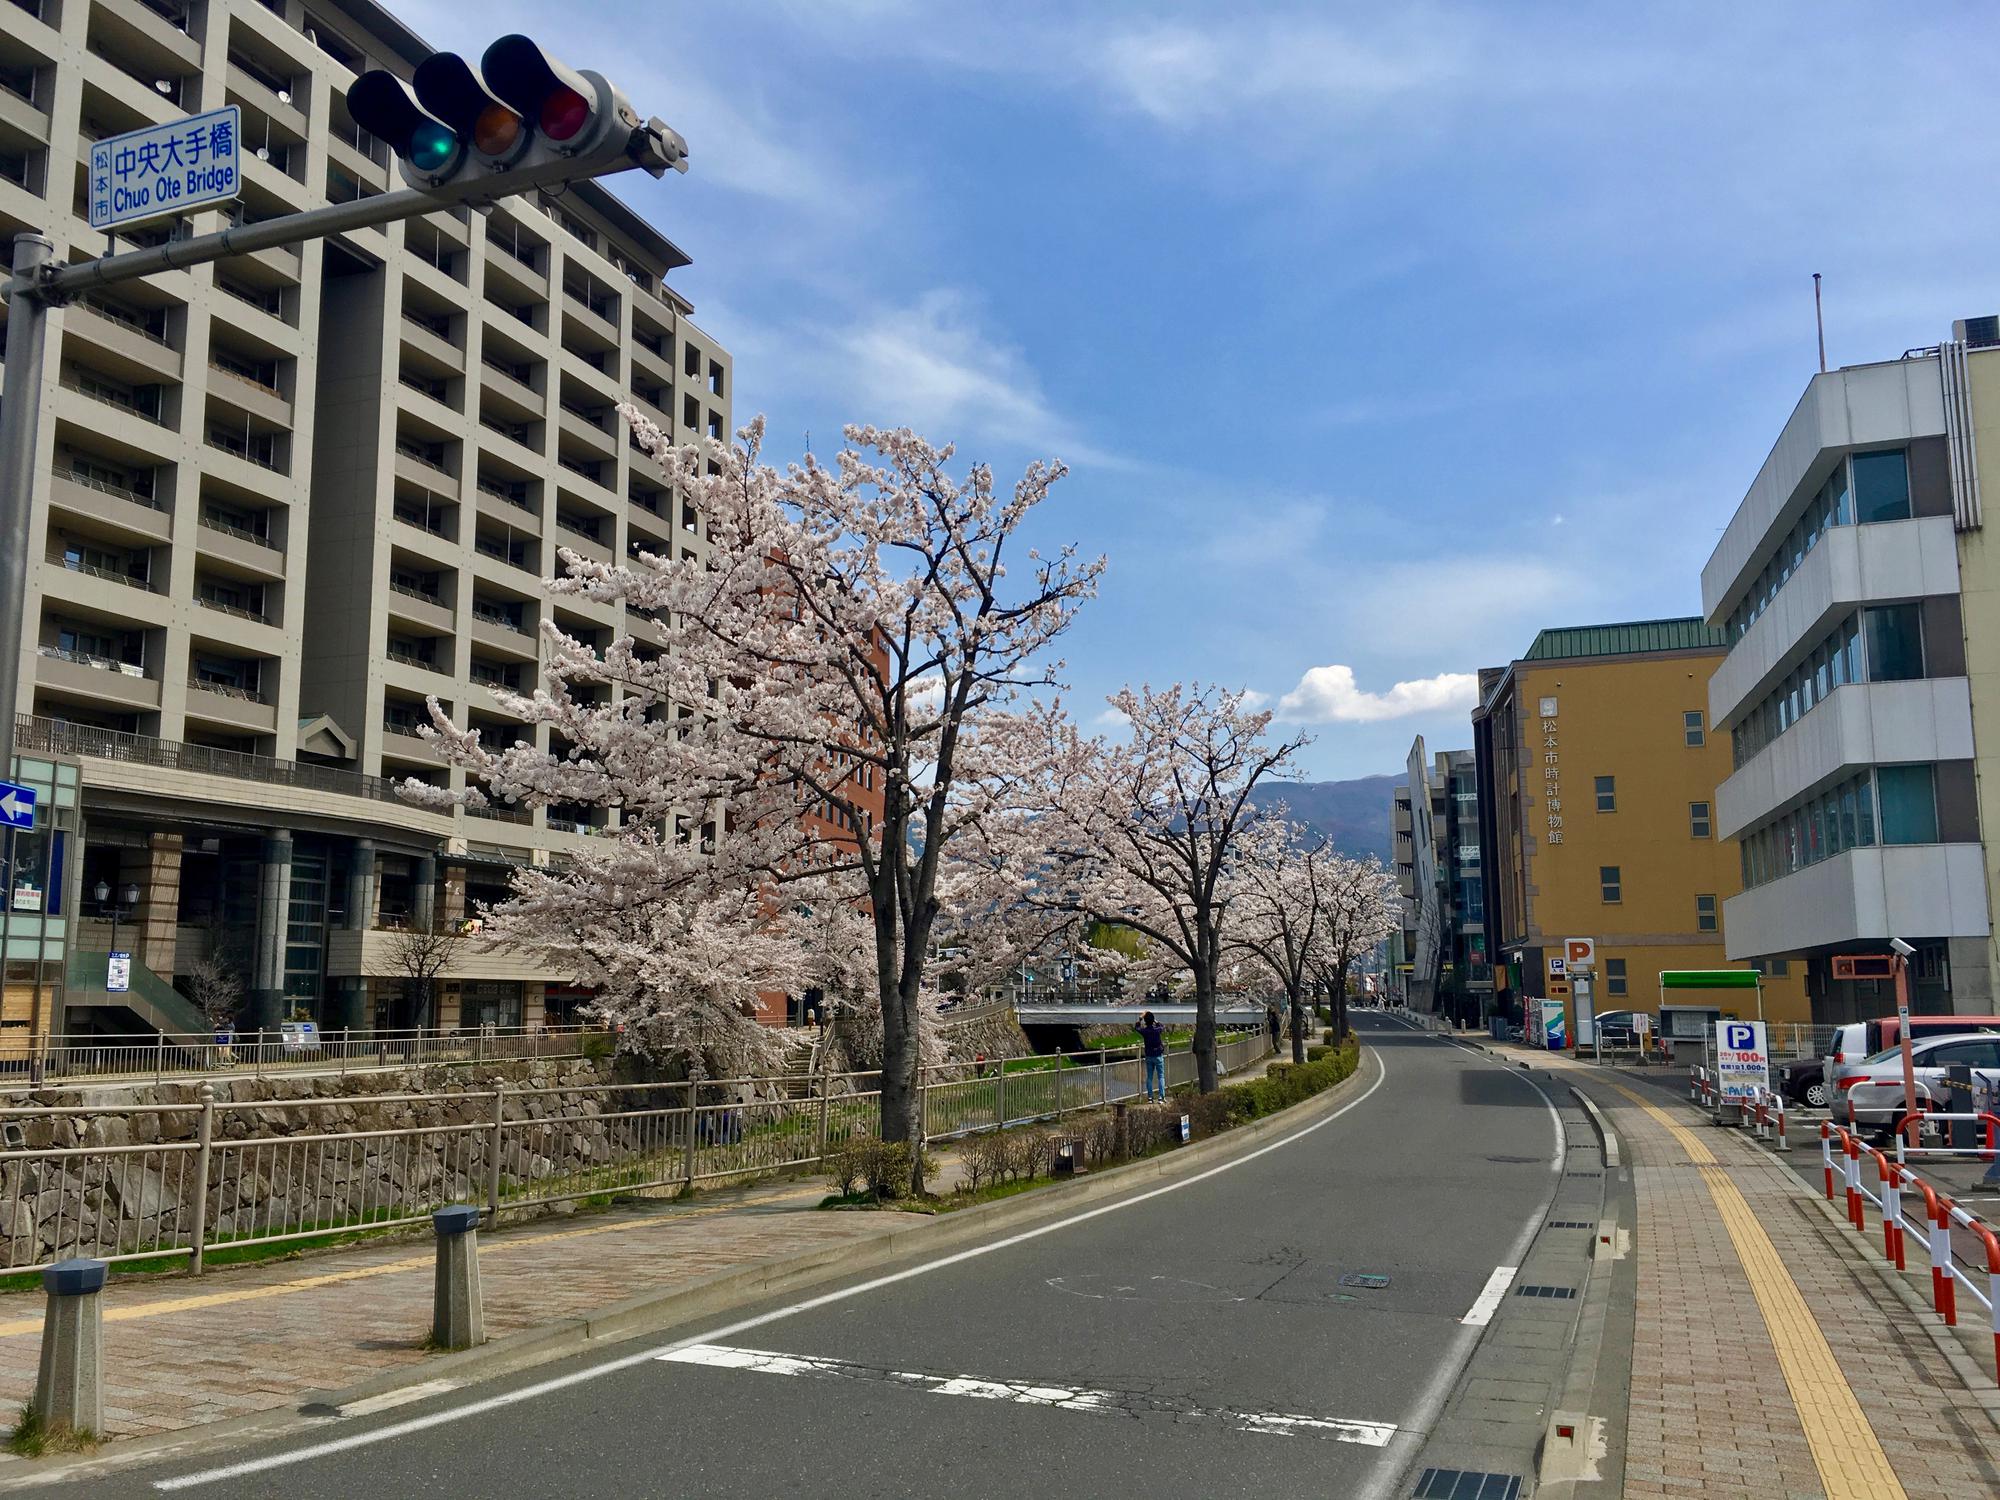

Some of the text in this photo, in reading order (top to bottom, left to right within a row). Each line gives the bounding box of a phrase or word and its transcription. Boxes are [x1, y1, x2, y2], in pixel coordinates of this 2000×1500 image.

[115, 120, 232, 183] 中央大手橋
[95, 151, 109, 218] 松本市
[114, 165, 234, 213] Chuo Ote Bridge
[1543, 720, 1563, 844] 松本市時計博物館
[1553, 960, 1562, 968] P
[1569, 942, 1590, 962] P
[1732, 1027, 1751, 1048] P
